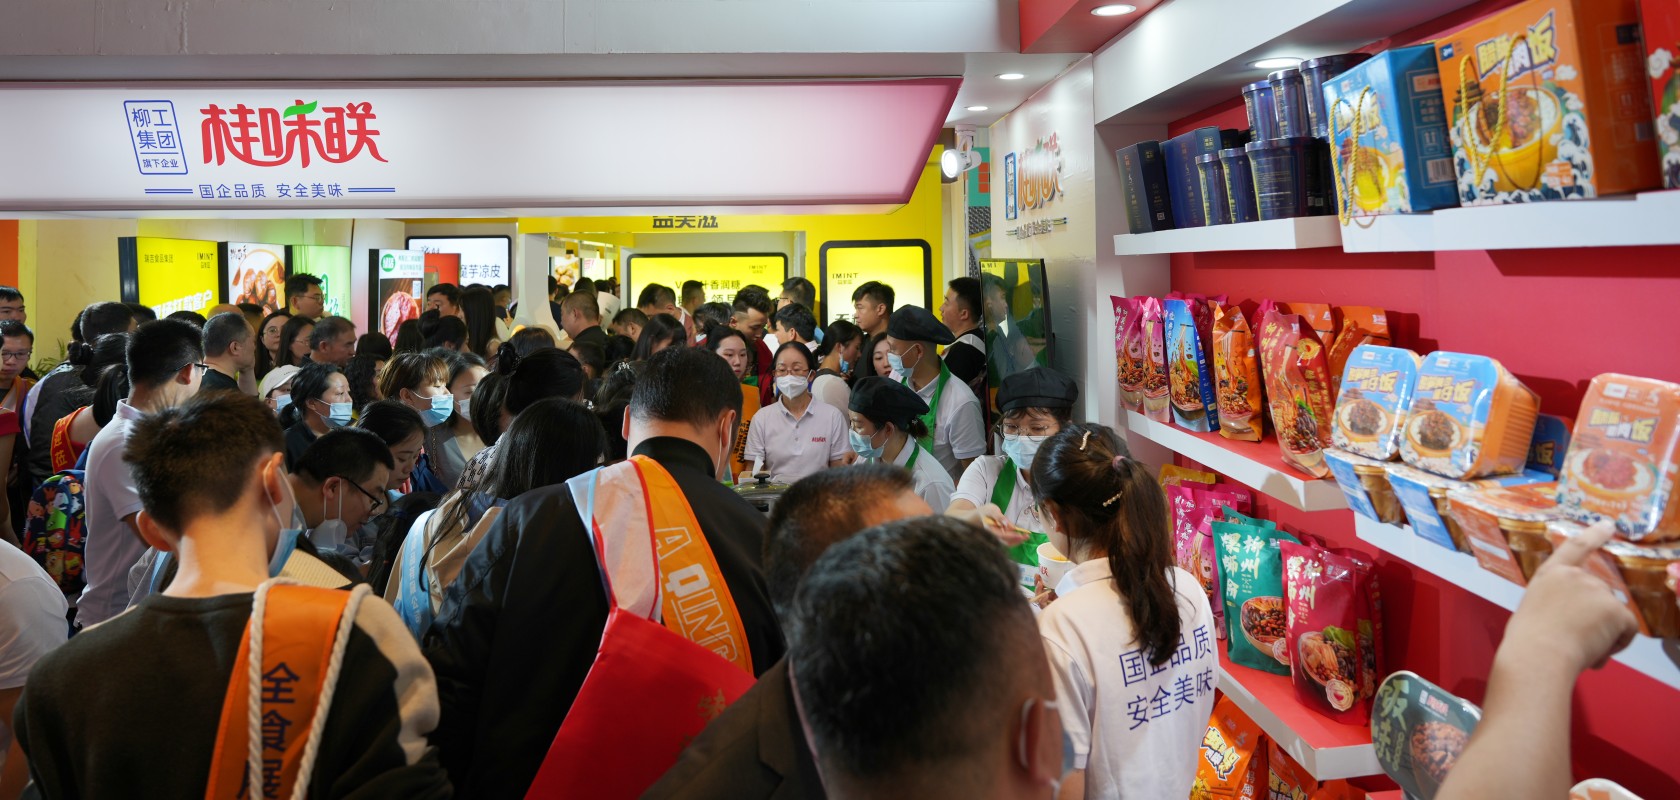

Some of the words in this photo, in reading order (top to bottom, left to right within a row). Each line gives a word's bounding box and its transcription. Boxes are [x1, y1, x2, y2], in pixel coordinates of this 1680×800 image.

[132, 108, 172, 128] 柳工
[137, 130, 176, 149] 集团
[200, 99, 389, 168] 桂味联
[142, 158, 179, 168] 旗下企业
[199, 183, 267, 199] 国企品质
[276, 182, 344, 198] 安全美味
[1127, 666, 1213, 731] 安全美味
